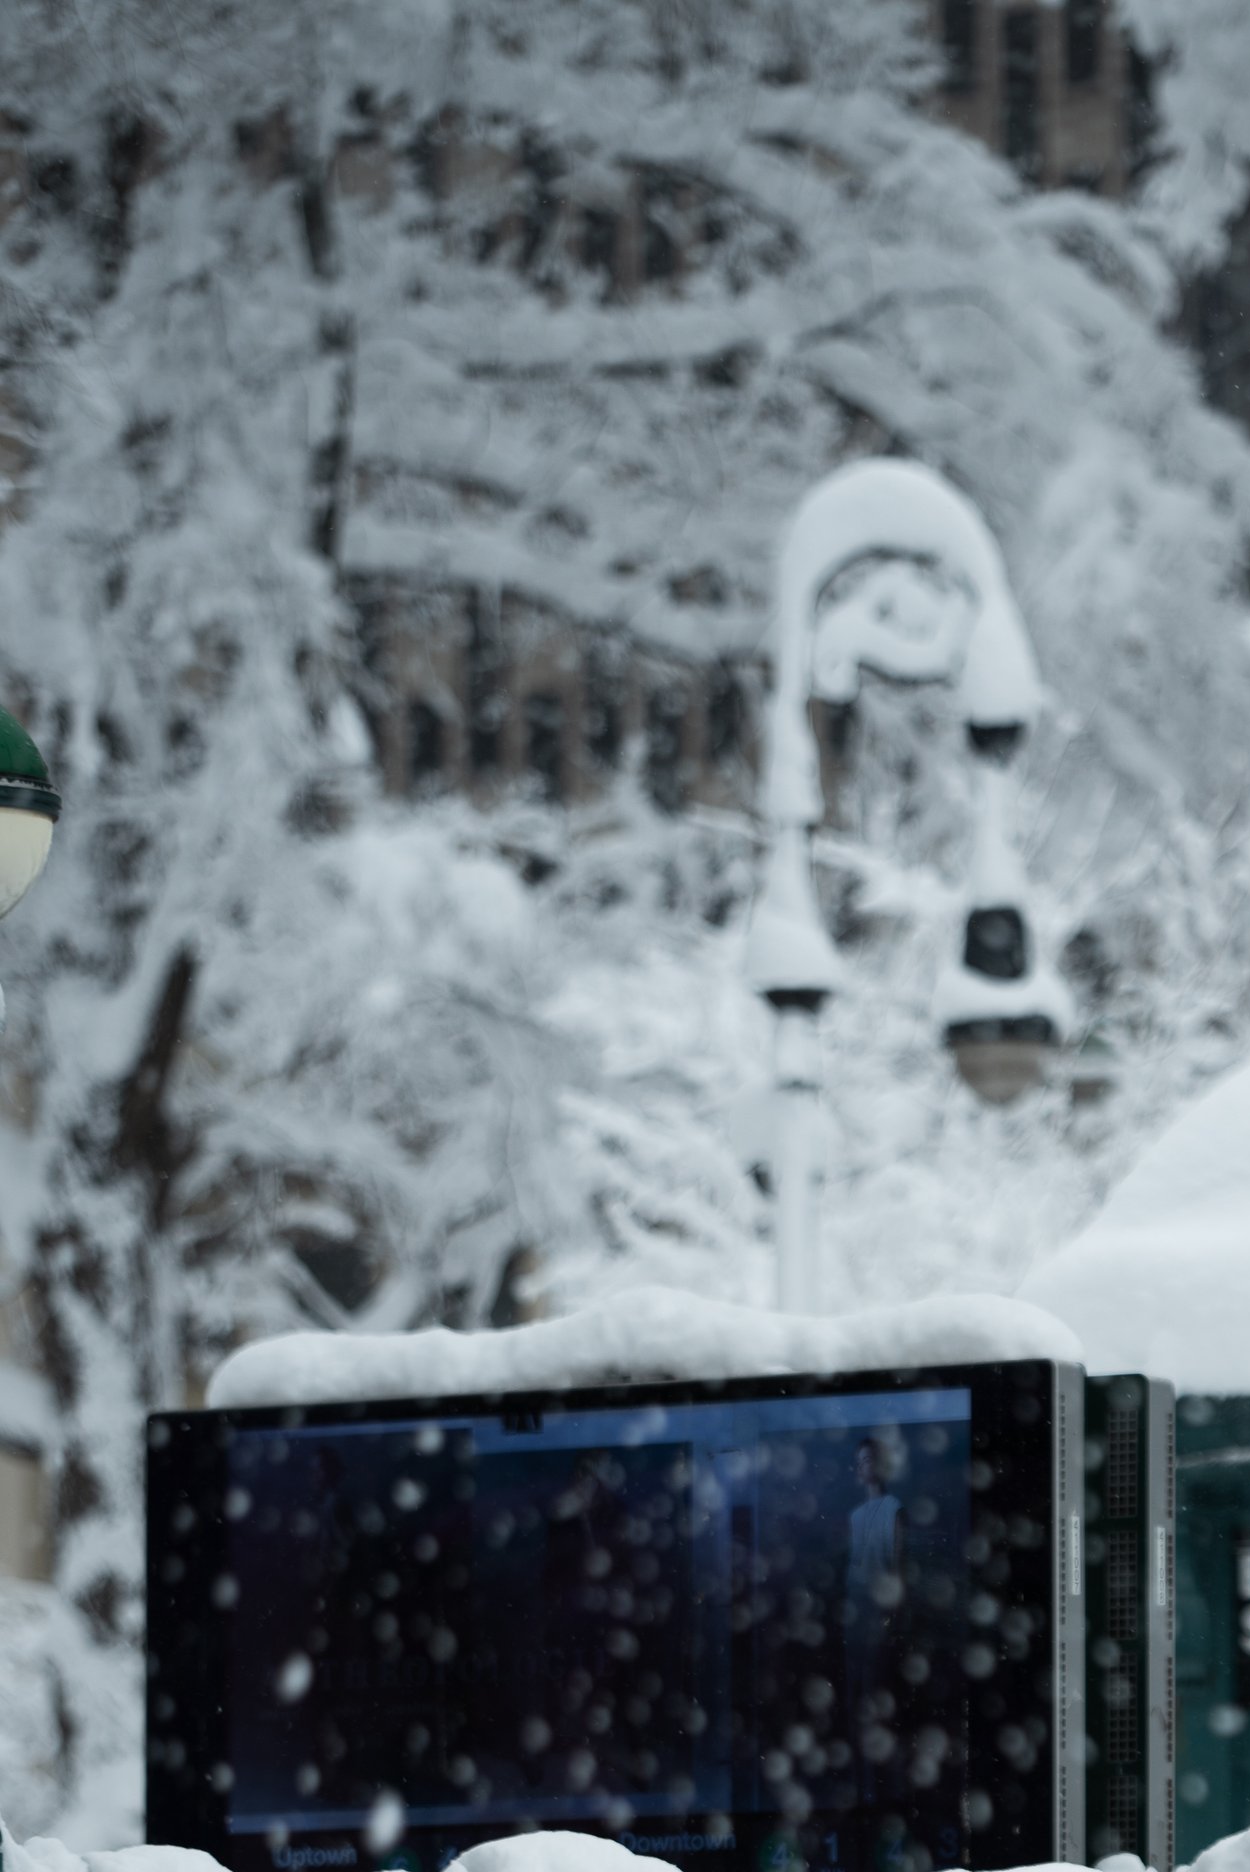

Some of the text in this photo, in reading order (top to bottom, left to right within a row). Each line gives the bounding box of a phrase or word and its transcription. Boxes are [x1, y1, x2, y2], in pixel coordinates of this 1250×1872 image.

[273, 1846, 358, 1870] Uptown
[619, 1831, 735, 1855] Downtown
[821, 1832, 837, 1863] 1
